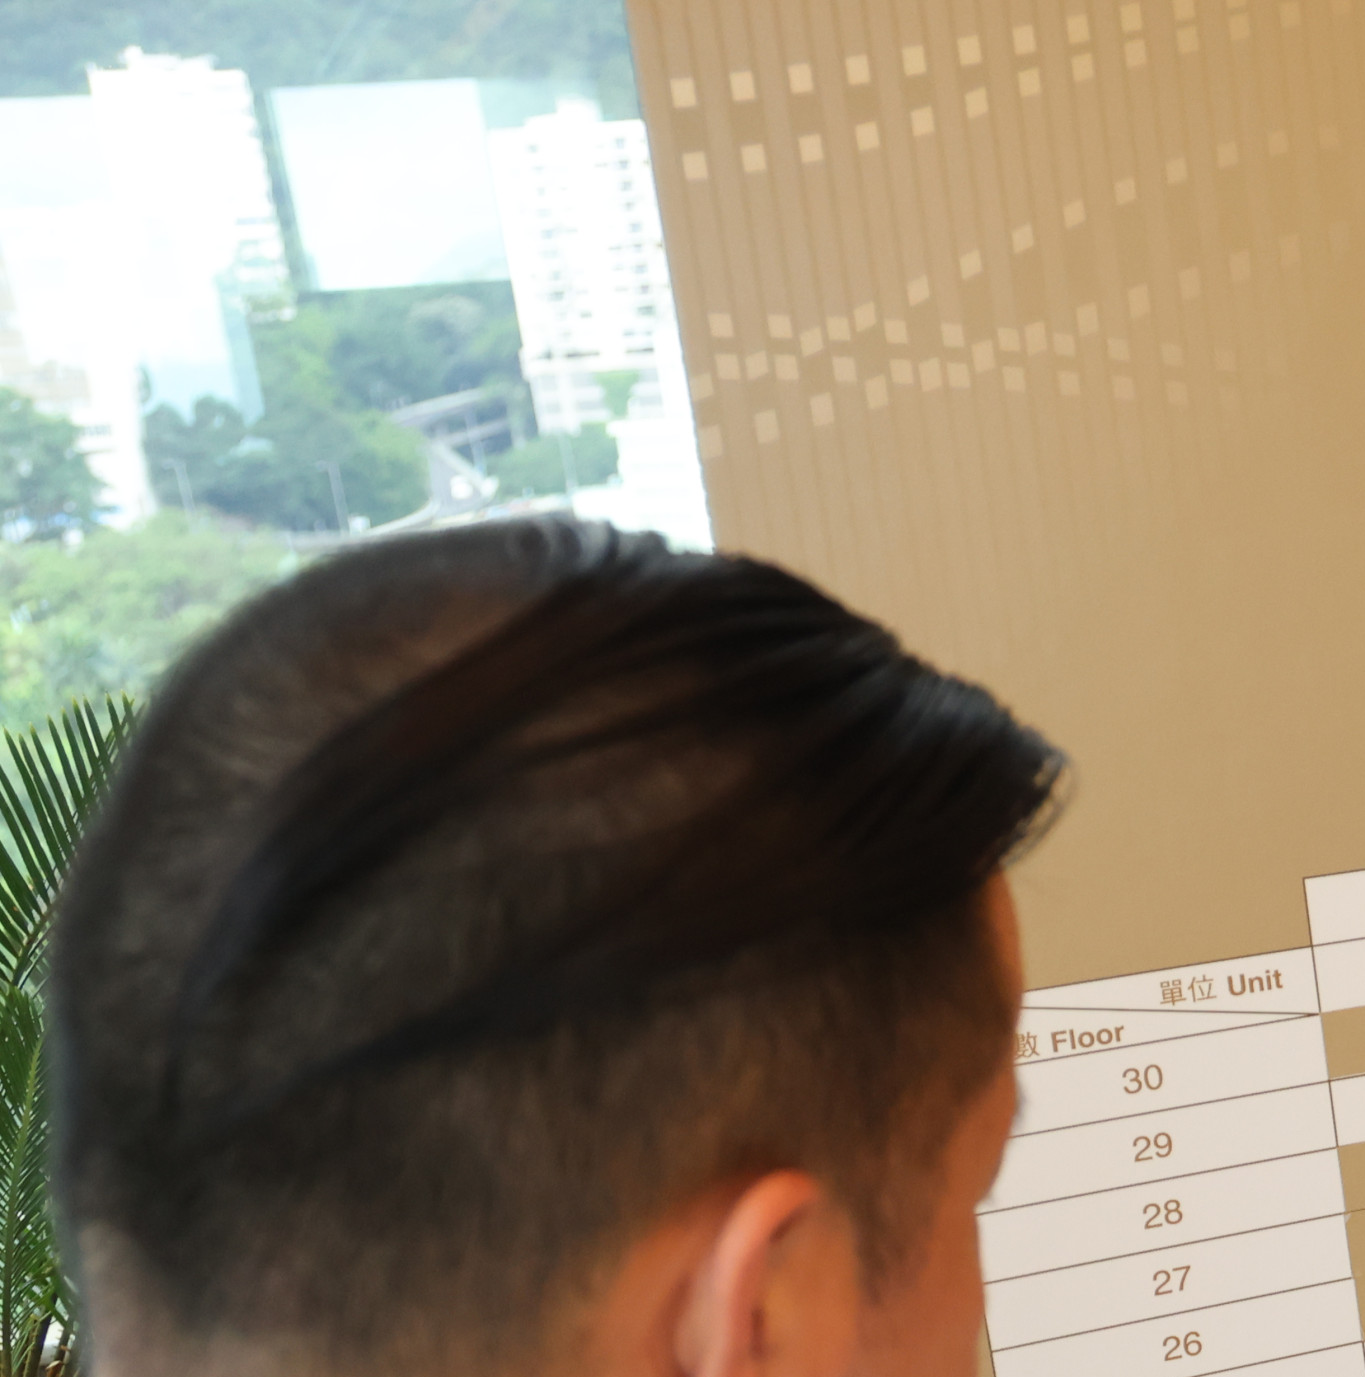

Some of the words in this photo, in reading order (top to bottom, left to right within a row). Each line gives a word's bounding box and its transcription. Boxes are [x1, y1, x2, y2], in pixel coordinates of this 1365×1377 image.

[1160, 975, 1215, 1007] 單位
[1227, 969, 1284, 998] Unit
[1051, 1025, 1125, 1052] Floor
[1122, 1065, 1163, 1094] 30
[1133, 1132, 1172, 1162] 29
[1143, 1200, 1183, 1229] 28
[1153, 1265, 1190, 1296] 27
[1163, 1332, 1202, 1361] 26
